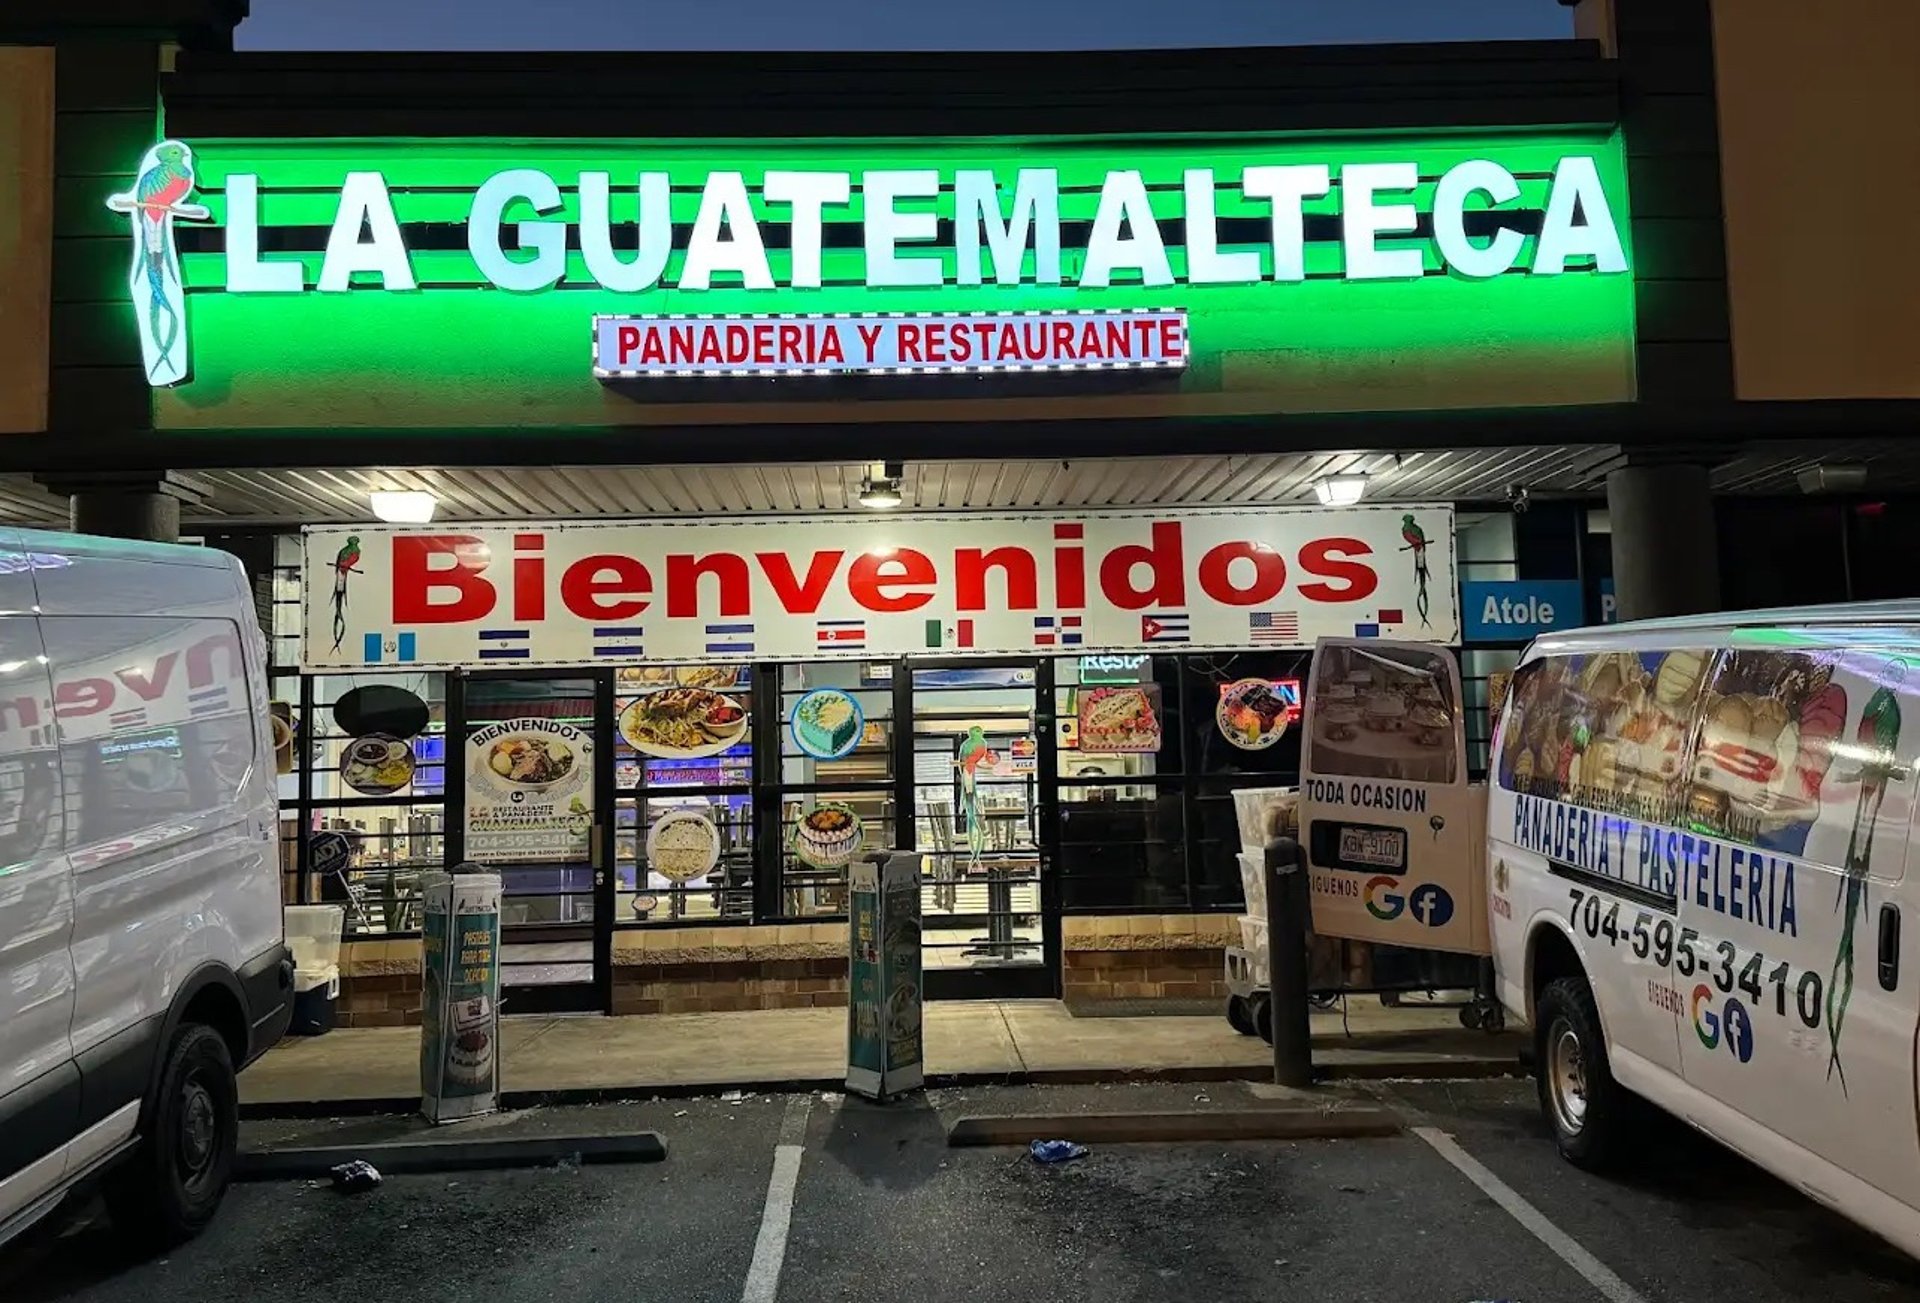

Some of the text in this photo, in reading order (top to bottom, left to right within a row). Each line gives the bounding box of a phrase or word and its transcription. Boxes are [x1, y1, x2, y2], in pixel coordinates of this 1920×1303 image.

[225, 156, 1629, 293] LA GUATEMALTECA
[617, 318, 1182, 365] PANADERIA Y RESTAURANTE
[391, 521, 1378, 625] Bienvenidos
[1481, 595, 1554, 624] Atole
[472, 719, 580, 747] BIENVENIDOS
[1306, 779, 1427, 814] TODA OCASION
[314, 836, 342, 867] ADT
[469, 834, 579, 848] 704-595-3410
[1513, 793, 1609, 876] PANADERIA
[1617, 817, 1631, 877] Y
[1640, 821, 1798, 938] PASTELERIA
[1311, 875, 1359, 897] IGUENOS
[1568, 888, 1823, 1030] 704-595-3410
[1647, 979, 1685, 1018] SIGUENOS
